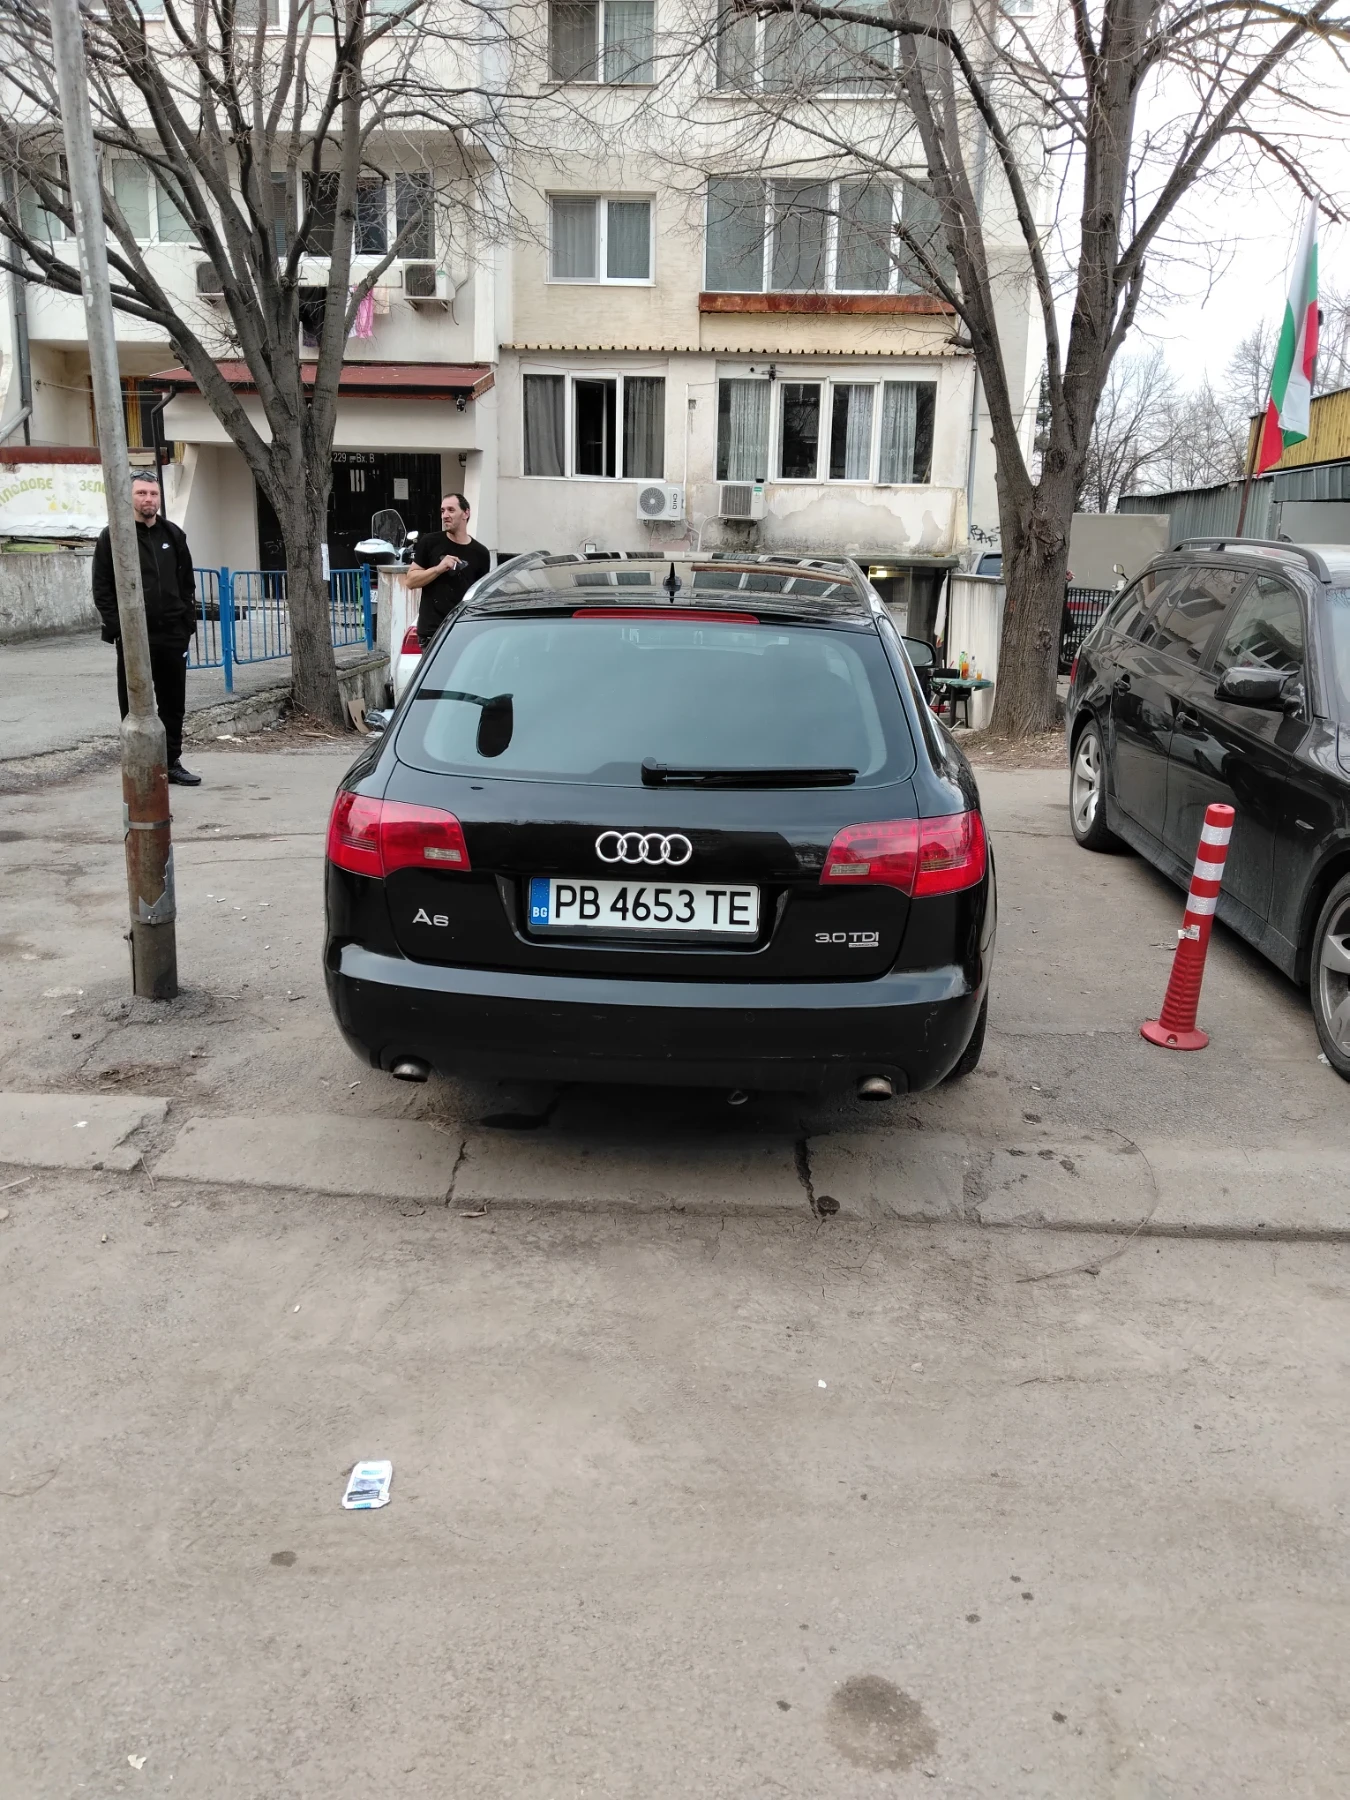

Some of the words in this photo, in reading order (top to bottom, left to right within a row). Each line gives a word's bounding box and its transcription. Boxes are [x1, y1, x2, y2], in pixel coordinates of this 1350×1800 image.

[333, 452, 347, 463] 229
[555, 884, 600, 920] PB
[609, 887, 696, 924] 4653
[705, 890, 752, 926] TE
[412, 908, 449, 927] A6
[532, 906, 548, 918] BG
[815, 931, 847, 943] 3.0
[848, 931, 880, 942] TDI
